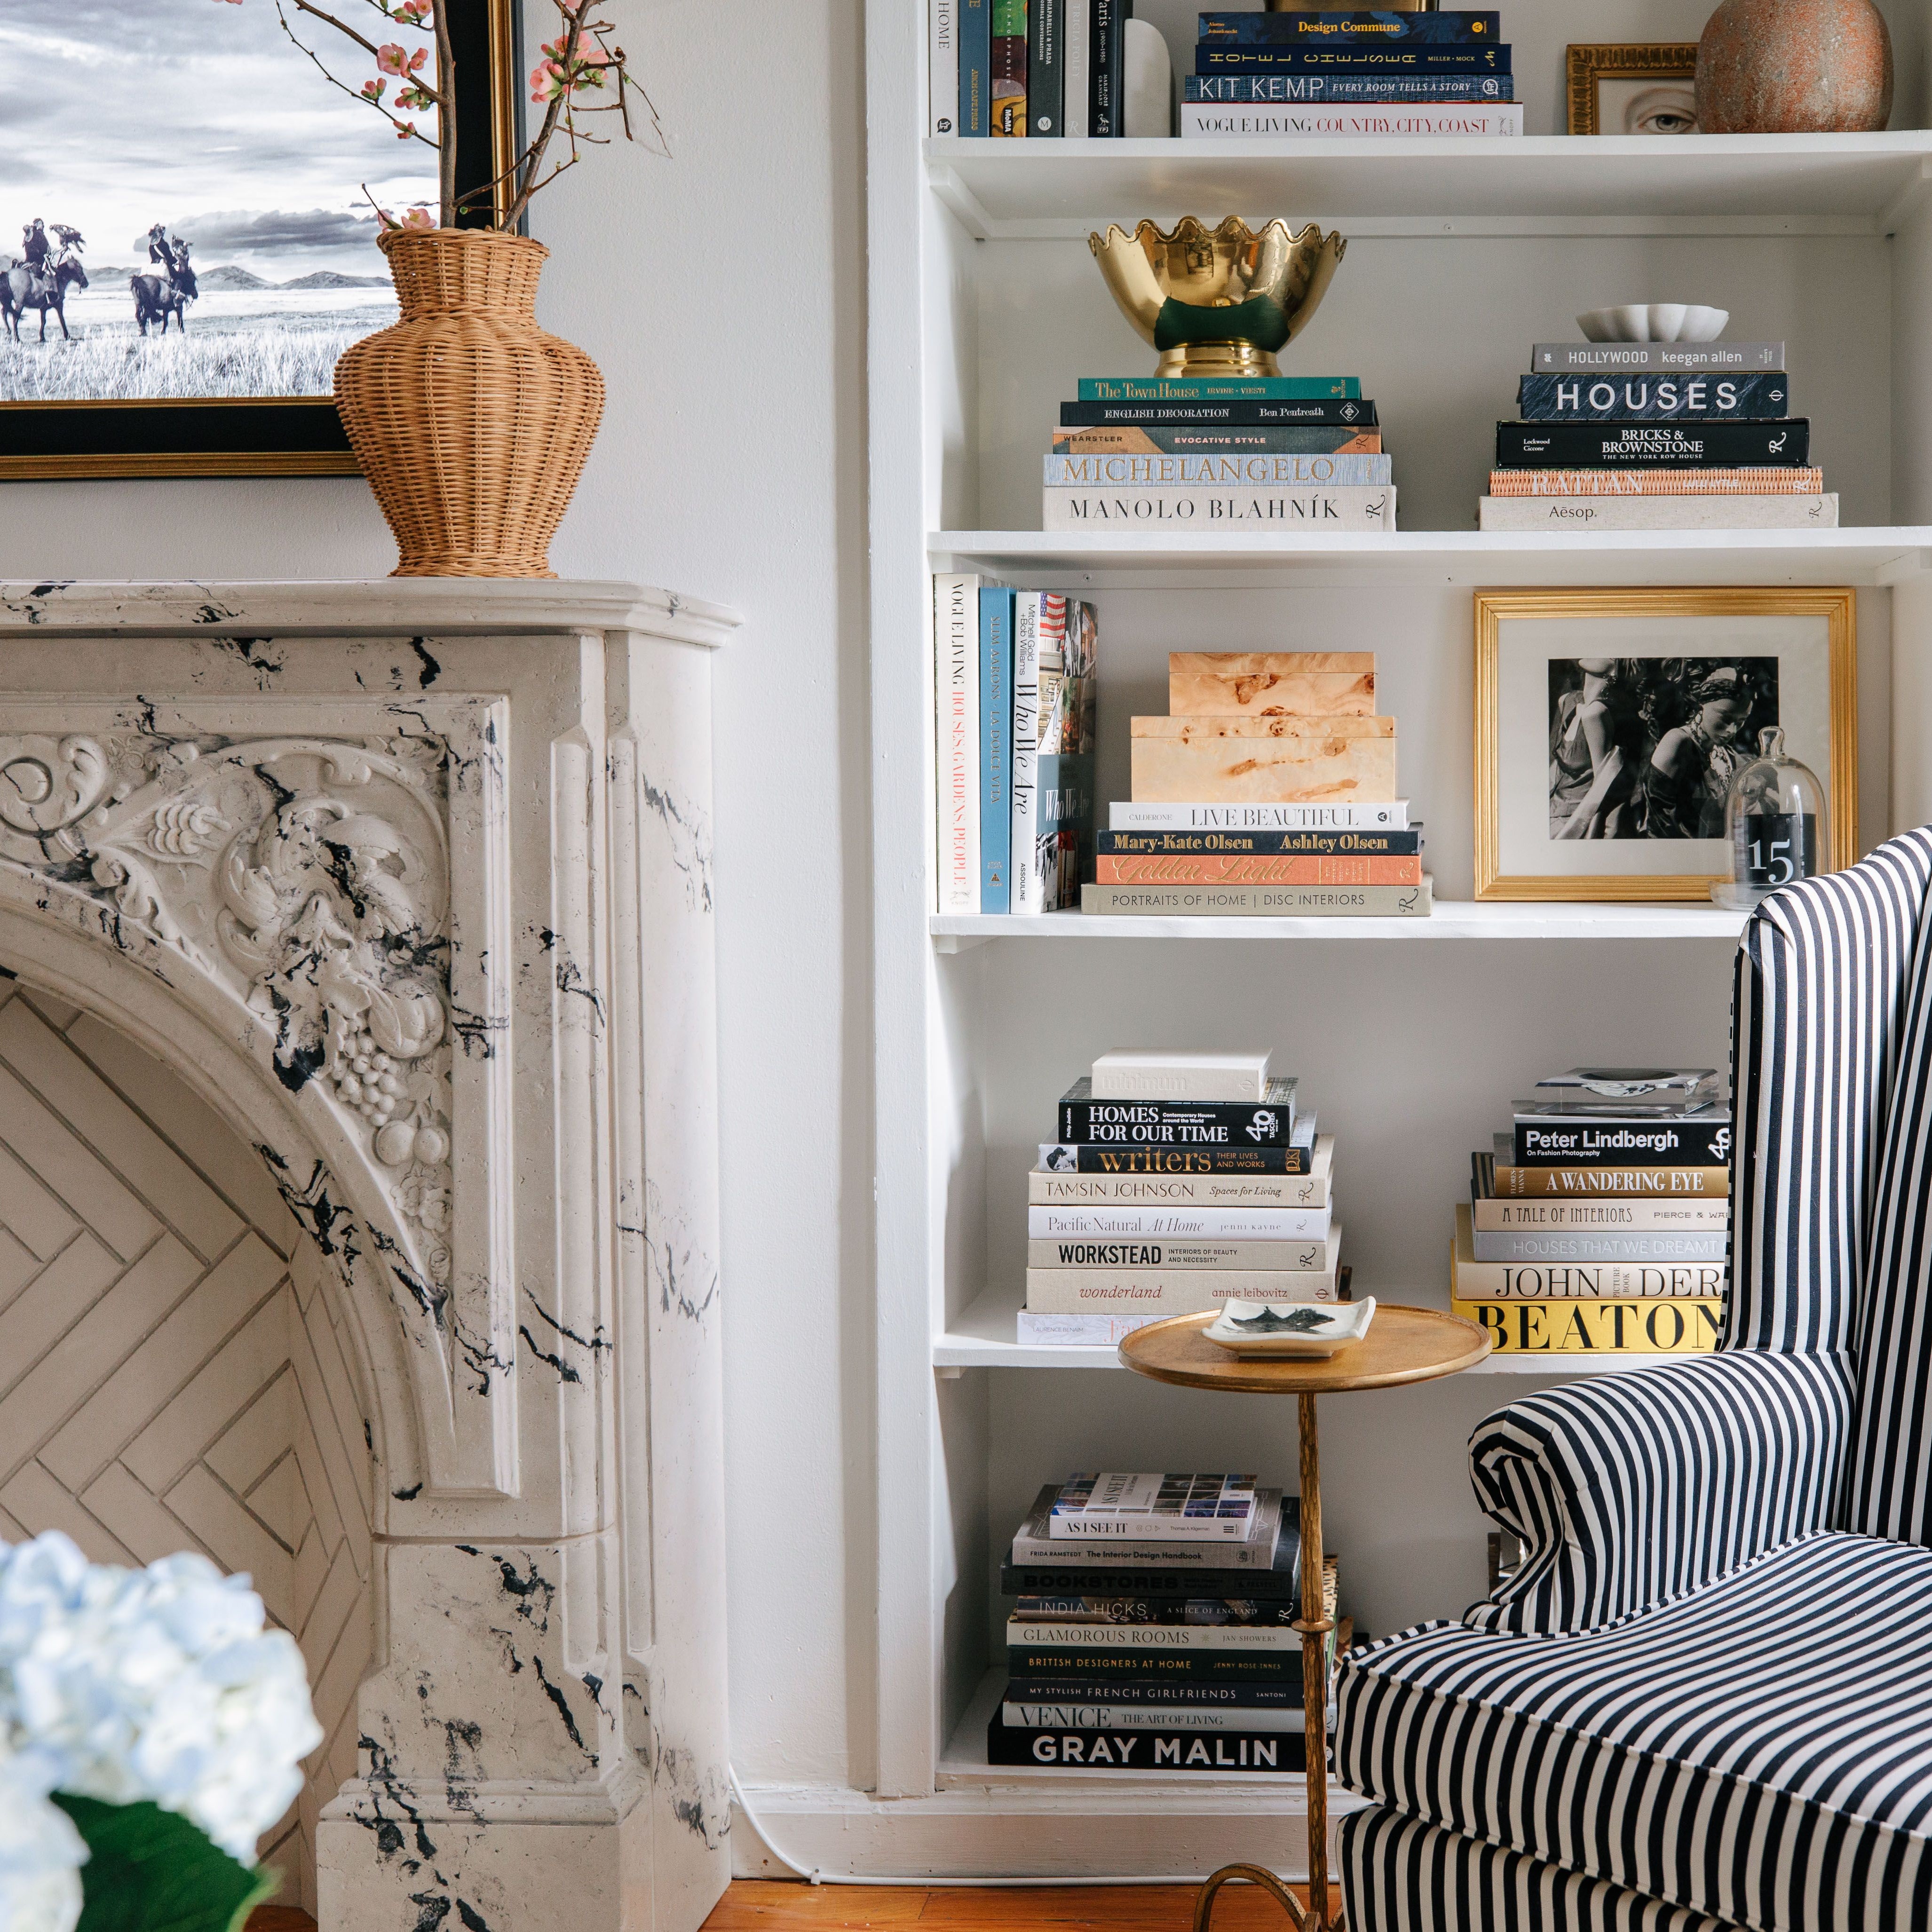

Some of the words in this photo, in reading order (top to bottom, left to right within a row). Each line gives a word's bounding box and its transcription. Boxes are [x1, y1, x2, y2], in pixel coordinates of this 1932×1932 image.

[938, 3, 949, 49] HOME
[1299, 21, 1339, 34] Design
[1341, 21, 1401, 32] Commune
[1200, 78, 1240, 98] KIT
[1251, 78, 1324, 98] KEMP
[1332, 83, 1363, 92] EVERY
[1568, 351, 1648, 363] HOLLYWOOD
[1662, 351, 1708, 366] keegan
[1711, 351, 1742, 363] allen
[1558, 383, 1737, 410] HOUSES
[1104, 409, 1155, 418] ENGLISH
[1157, 408, 1230, 418] DECORATION
[1259, 408, 1278, 417] Ben
[1279, 407, 1325, 417] Pentreath
[1622, 429, 1671, 441] BRICKS
[1673, 430, 1684, 440] &
[1602, 441, 1703, 453] BROWNSTONE
[1063, 458, 1334, 482] MICHELANGELO
[1069, 499, 1195, 518] MANOLO
[1209, 494, 1340, 518] BLAHNÍK
[991, 616, 1000, 645] SLIM
[1019, 639, 1027, 676] Williams
[991, 649, 1000, 700] AARONS
[991, 711, 1000, 727] LA
[990, 729, 1000, 772] DOLCE
[991, 776, 1000, 804] VITA
[1191, 809, 1237, 826] LIVE
[1243, 808, 1359, 825] BEAUTIFUL
[1113, 834, 1202, 853] Mary-Kate
[1205, 834, 1253, 849] Olsen
[1279, 834, 1337, 853] Ashley
[1339, 834, 1388, 849] Olsen
[1748, 838, 1794, 885] 15
[1112, 895, 1178, 906] PORTRAITS
[1184, 895, 1202, 905] OF
[1208, 895, 1246, 905] HOME
[1264, 895, 1293, 905] DISC
[1299, 895, 1364, 905] INTERIORS
[1089, 1107, 1159, 1123] HOMES
[1089, 1124, 1128, 1141] FOR
[1132, 1125, 1174, 1141] OUR
[1178, 1126, 1228, 1142] TIME
[1526, 1131, 1578, 1148] Peter
[1583, 1130, 1679, 1152] Lindbergh
[1098, 1147, 1211, 1172] writers
[1045, 1182, 1106, 1196] TAMSIN
[1114, 1183, 1194, 1197] JOHNSON
[1209, 1186, 1238, 1197] Spaces
[1239, 1186, 1253, 1197] for
[1254, 1186, 1282, 1198] Living
[1546, 1172, 1559, 1190] A
[1560, 1172, 1666, 1191] WANDERING
[1670, 1172, 1704, 1191] EYE
[1048, 1216, 1092, 1231] Pacific
[1093, 1217, 1141, 1231] Natural
[1147, 1216, 1163, 1231] At
[1167, 1218, 1204, 1232] Home
[1503, 1208, 1511, 1221] A
[1516, 1208, 1545, 1222] TALE
[1551, 1208, 1565, 1222] OF
[1571, 1208, 1633, 1222] INTERIORS
[1058, 1245, 1162, 1264] WORKSTEAD
[1079, 1285, 1162, 1298] wonderland
[1211, 1289, 1241, 1297] annie
[1244, 1288, 1288, 1297] leibovitz
[1473, 1304, 1721, 1350] BEATON
[1133, 1552, 1160, 1560] Design
[1039, 1602, 1085, 1615] INDIA
[1094, 1603, 1147, 1616] HICKS
[1023, 1629, 1125, 1642] GLAMOROUS
[1132, 1631, 1189, 1643] ROOMS
[1077, 1659, 1137, 1668] DESIGNERS
[1088, 1688, 1140, 1697] FRENCH
[1148, 1689, 1236, 1699] GIRLFRIENDS
[1020, 1706, 1111, 1728] VENICE
[1122, 1714, 1144, 1724] THE
[1146, 1715, 1167, 1724] ART
[1169, 1715, 1185, 1724] OF
[1186, 1715, 1223, 1725] LIVING
[1032, 1735, 1137, 1763] GRAY
[1155, 1738, 1277, 1766] MALIN
